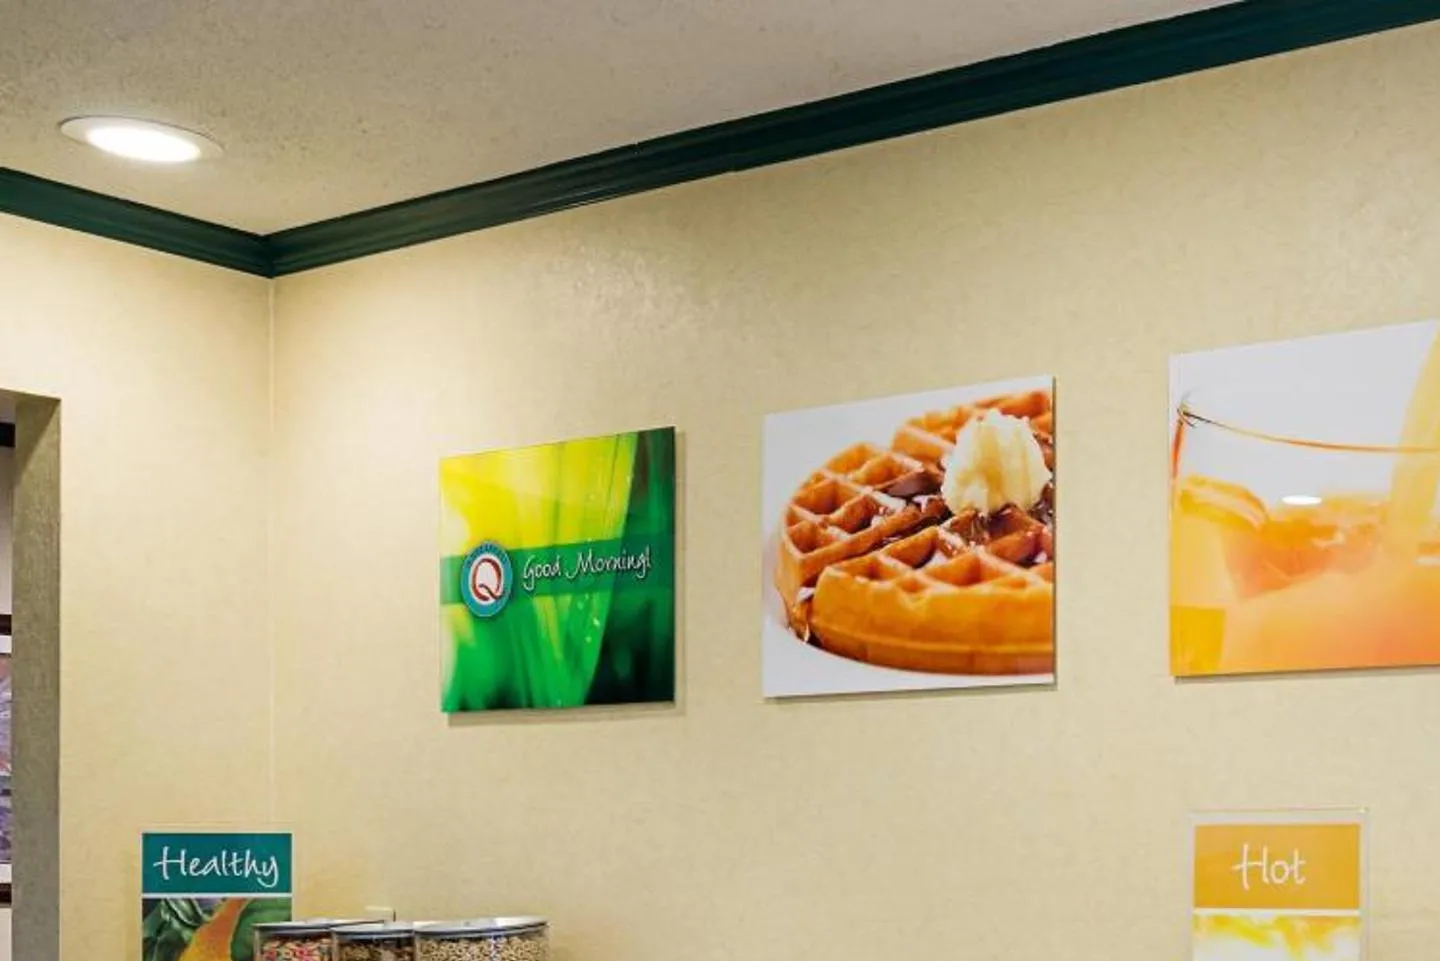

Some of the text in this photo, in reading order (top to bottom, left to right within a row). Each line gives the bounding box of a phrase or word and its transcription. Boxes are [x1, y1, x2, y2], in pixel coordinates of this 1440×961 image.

[471, 557, 504, 603] Q
[522, 553, 562, 591] Good
[565, 544, 652, 580] Morning!
[152, 845, 280, 889] Healthy
[1230, 843, 1307, 892] Hot
